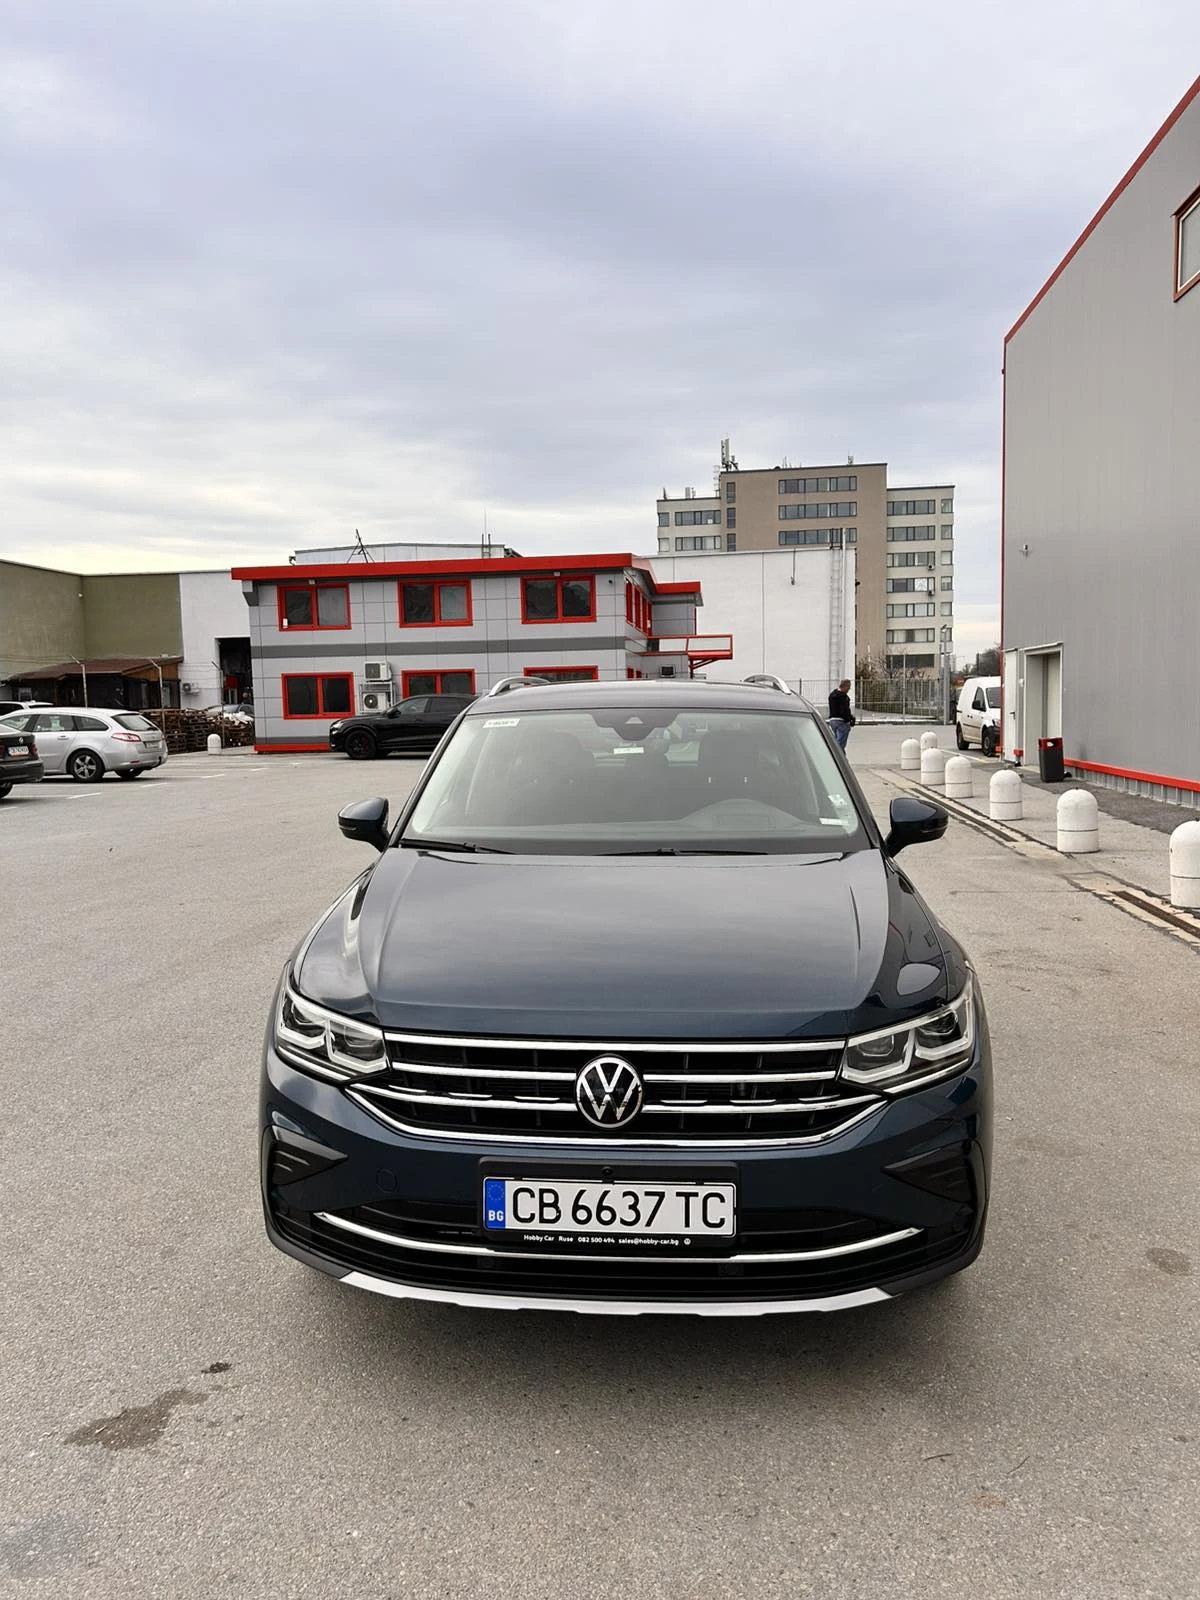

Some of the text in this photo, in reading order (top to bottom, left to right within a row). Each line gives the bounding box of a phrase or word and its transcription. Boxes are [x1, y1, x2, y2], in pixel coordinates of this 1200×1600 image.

[512, 1187, 726, 1229] CB 6637 TC
[488, 1210, 505, 1222] BG
[523, 1234, 543, 1242] Hobby
[618, 1237, 679, 1246] sales@hobby-car.bg
